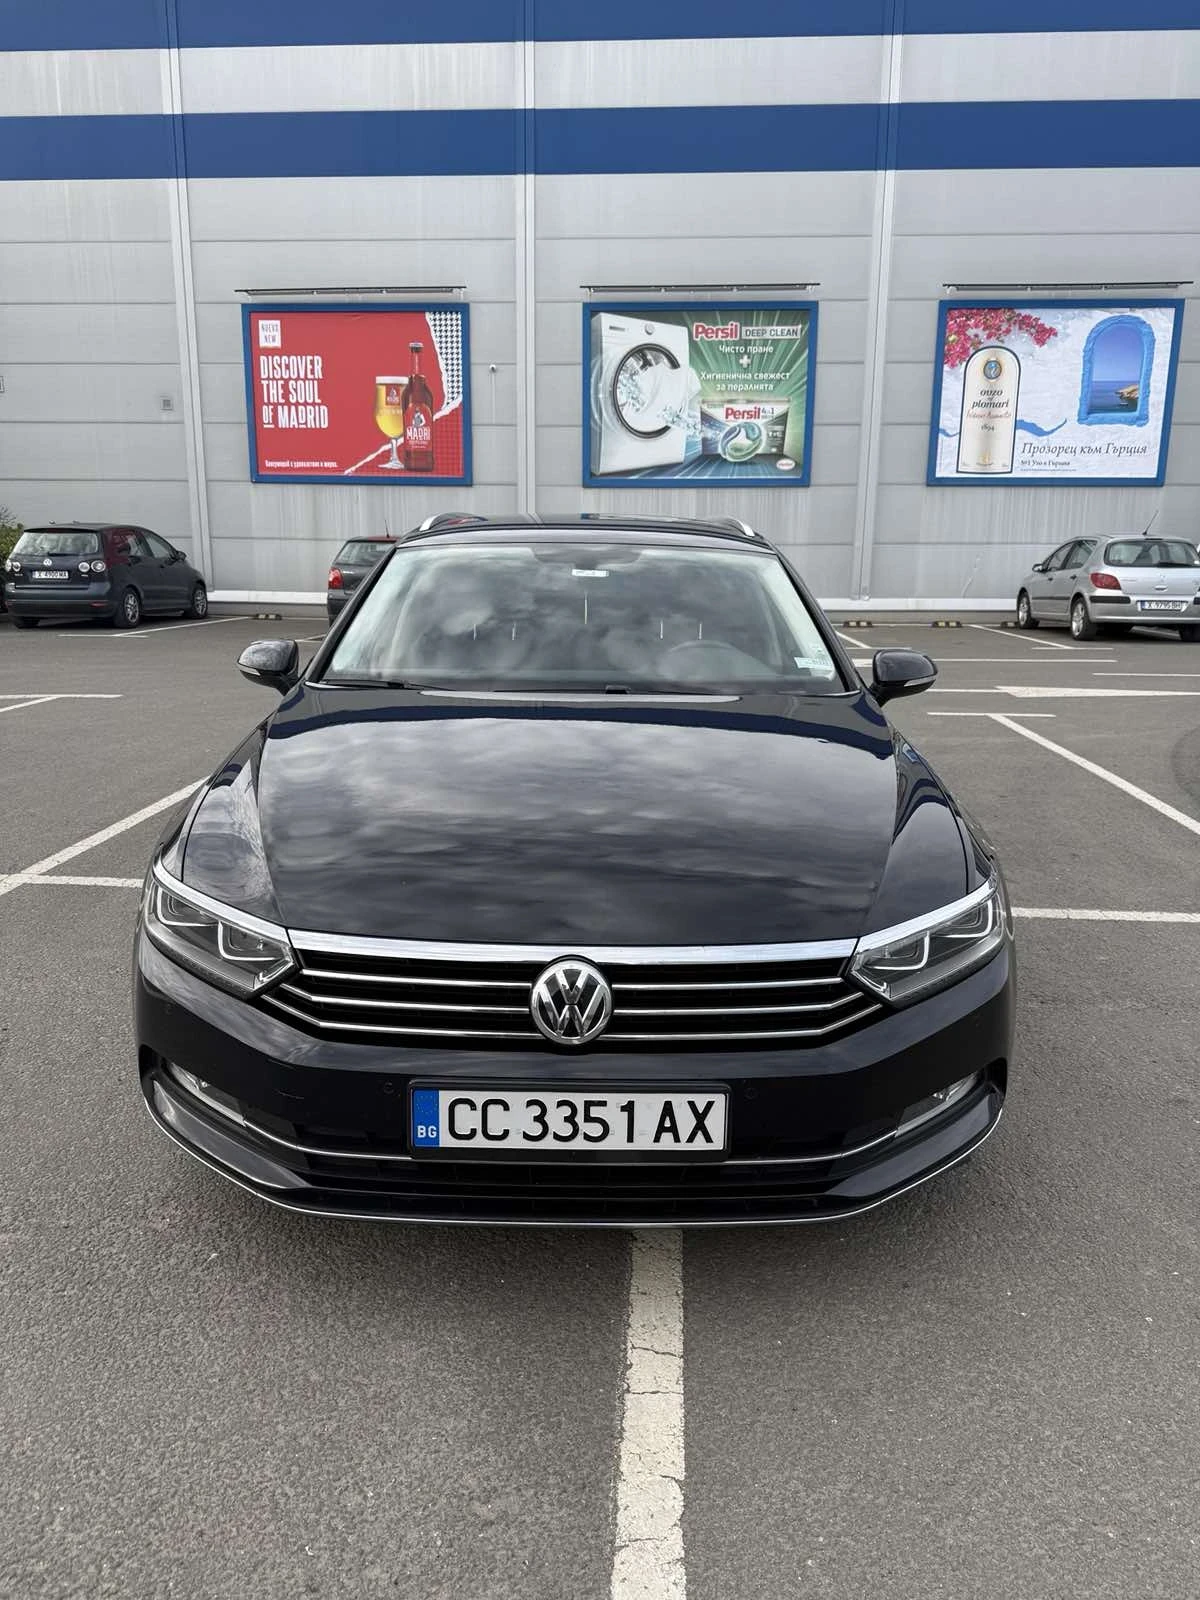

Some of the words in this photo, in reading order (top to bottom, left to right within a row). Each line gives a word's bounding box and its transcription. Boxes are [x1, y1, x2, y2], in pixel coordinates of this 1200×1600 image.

[694, 322, 739, 339] Persil
[745, 328, 767, 337] DEEP
[769, 328, 799, 337] CLEAN
[264, 334, 277, 344] NEW
[719, 345, 745, 353] Чисто
[747, 346, 774, 354] пране
[259, 355, 323, 379] DISCOVER
[701, 371, 752, 380] Хигиенична
[754, 372, 790, 380] свежест
[261, 380, 286, 404] THE
[289, 380, 322, 404] SOUL
[727, 383, 774, 392] пералнята
[972, 399, 1009, 409] plomari
[262, 405, 275, 428] OF
[277, 405, 329, 428] MADRID
[725, 406, 760, 419] Persil
[1021, 442, 1077, 457] Прозорец
[1079, 445, 1102, 454] към
[1105, 442, 1147, 457] Гърция
[416, 1125, 437, 1138] BG
[448, 1097, 510, 1142] CC
[522, 1099, 635, 1144] 3351
[652, 1099, 716, 1144] AX
